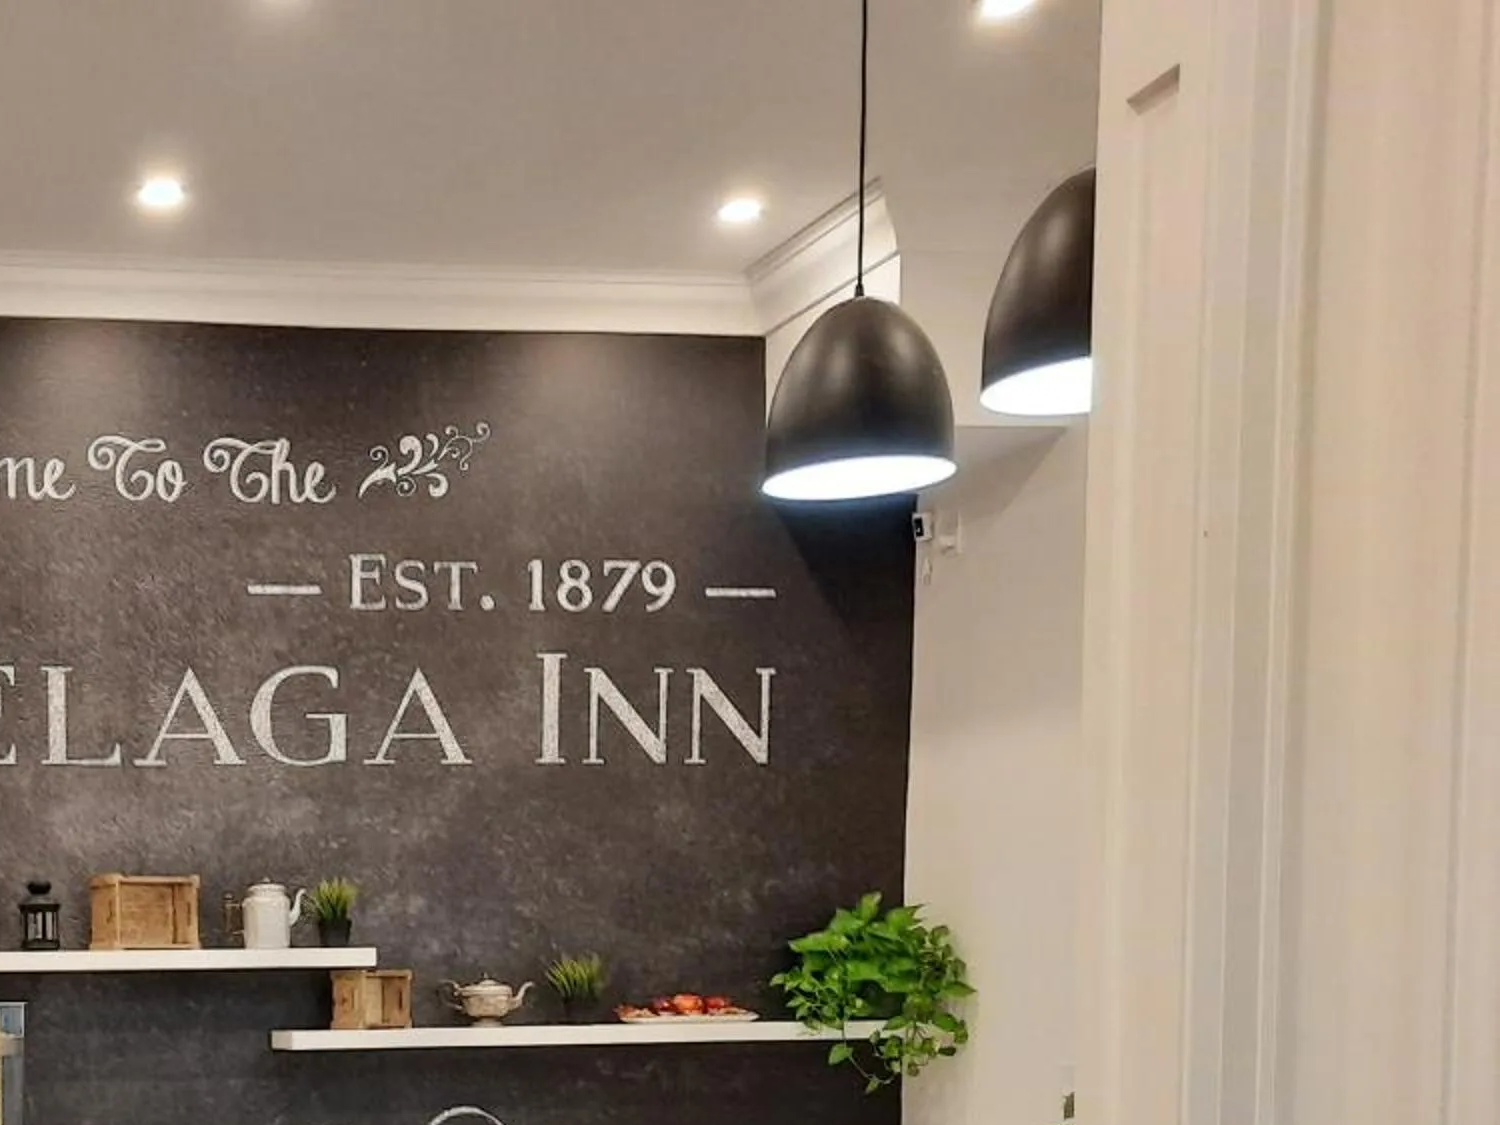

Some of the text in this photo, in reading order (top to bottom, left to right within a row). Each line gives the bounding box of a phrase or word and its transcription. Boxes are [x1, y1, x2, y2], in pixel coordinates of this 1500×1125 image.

[87, 435, 188, 503] To
[202, 437, 337, 505] The
[349, 553, 677, 613] EST. 1879
[534, 652, 777, 765] INN
